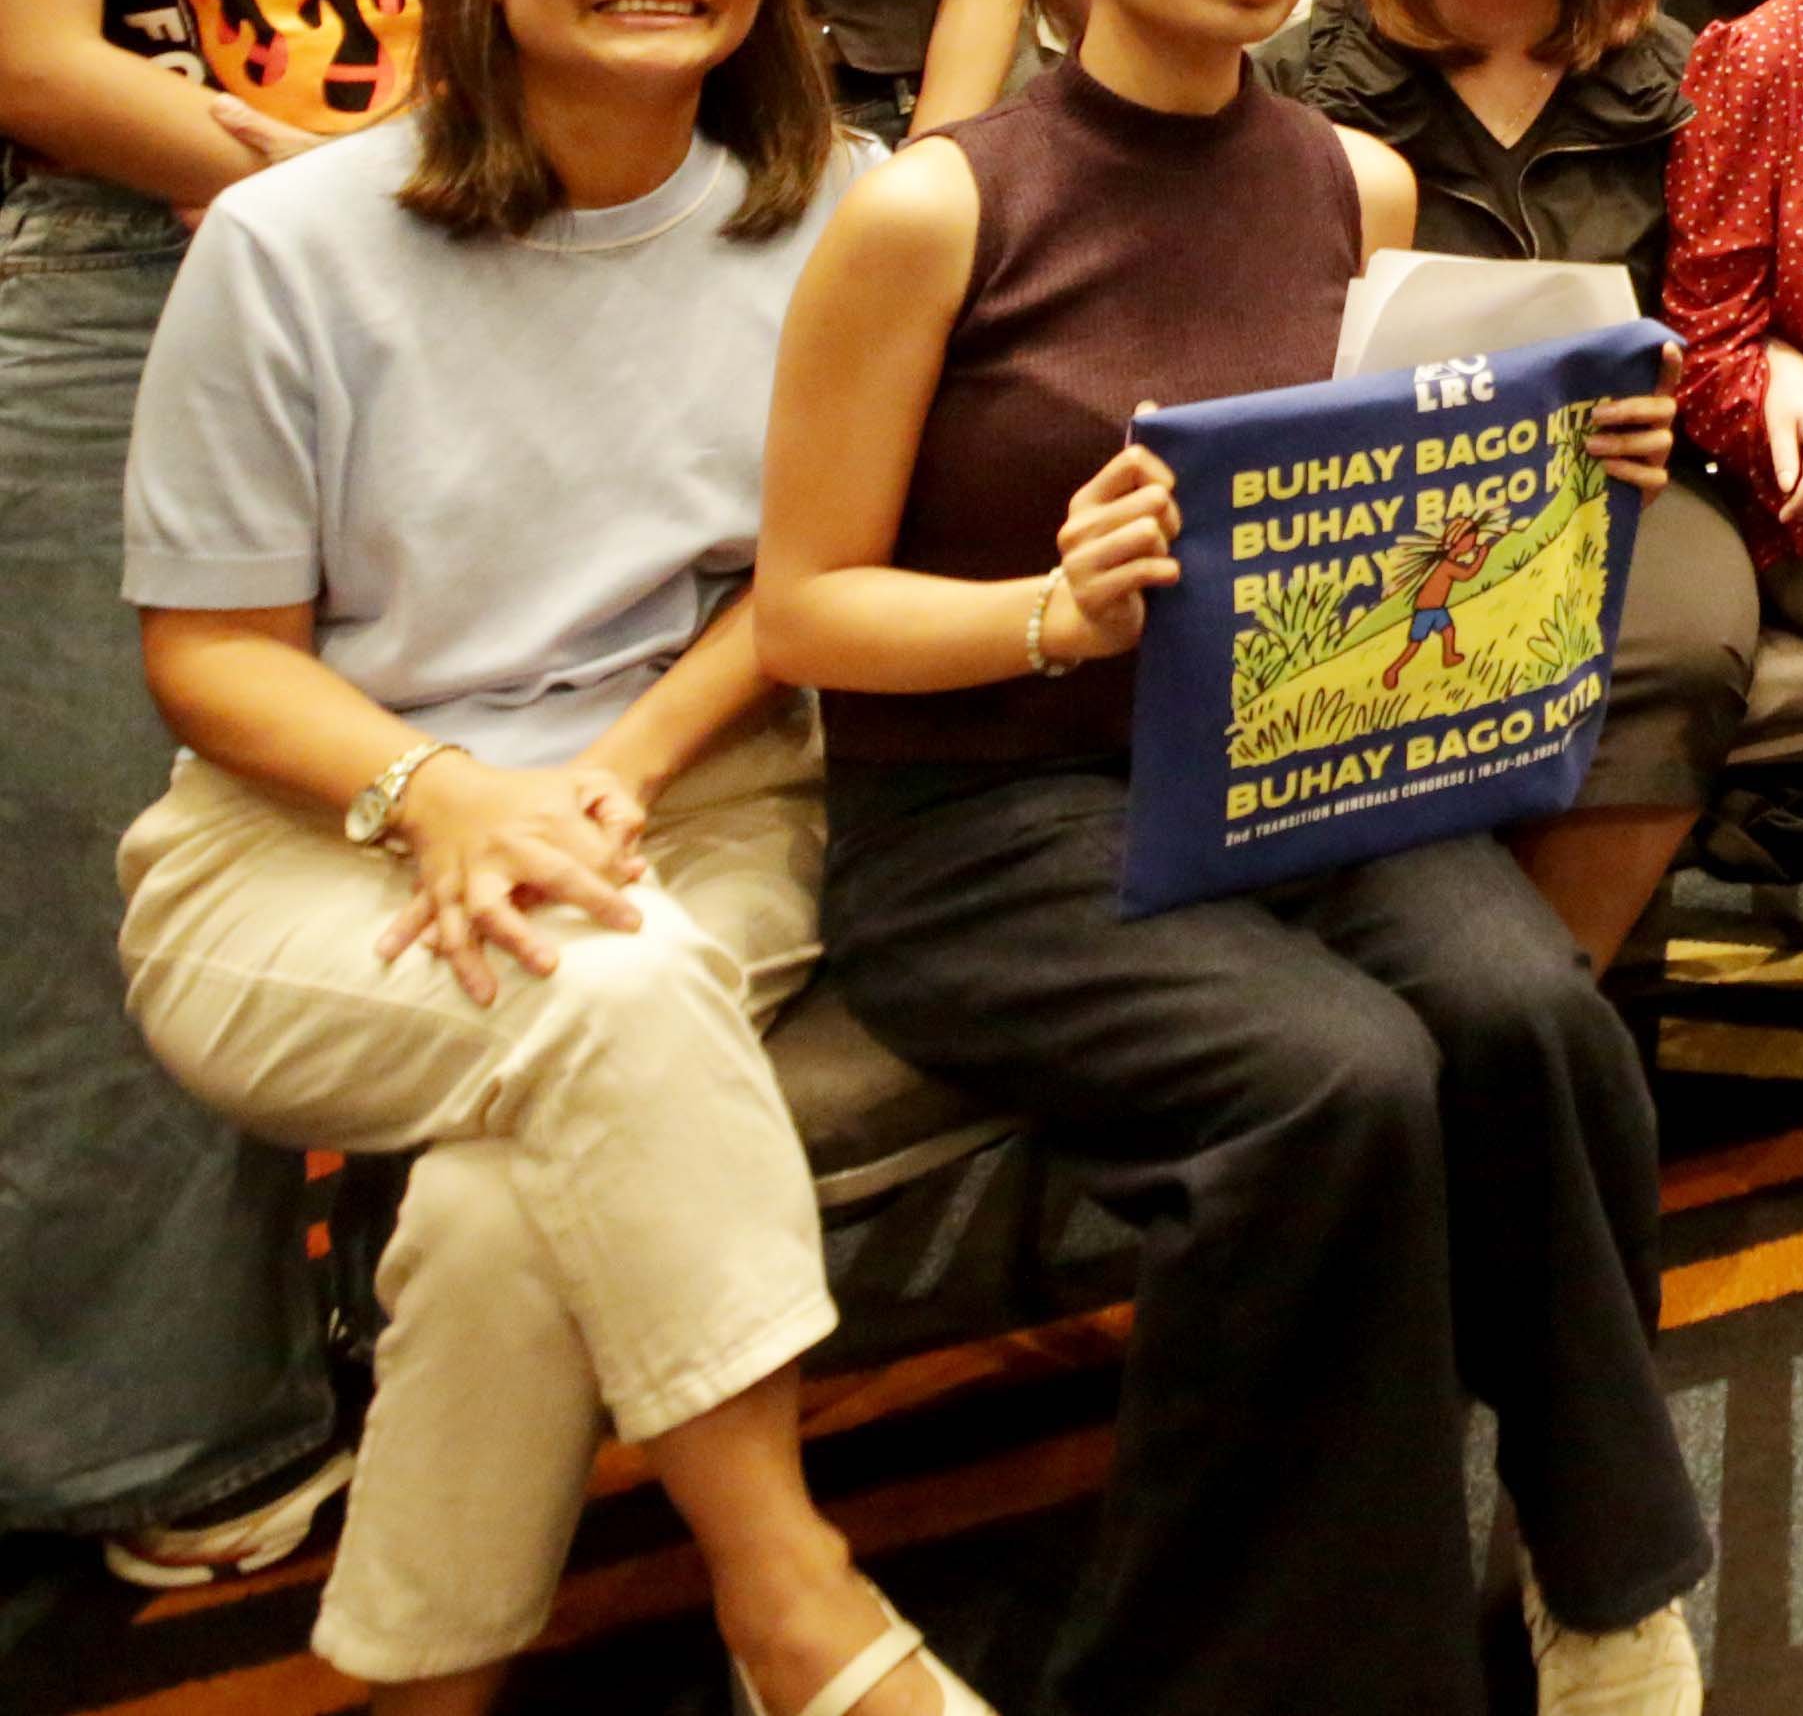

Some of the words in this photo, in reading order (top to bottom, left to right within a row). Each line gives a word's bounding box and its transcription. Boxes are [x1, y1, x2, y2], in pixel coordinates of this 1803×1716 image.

[1416, 370, 1495, 413] LRC
[1231, 445, 1404, 510] BUHAY
[1415, 418, 1539, 476] BAGO
[1231, 496, 1404, 561] BUHAY
[1226, 744, 1395, 821] BUHAY
[1405, 707, 1533, 772] BAGO
[1544, 672, 1602, 733] KITA
[1225, 829, 1251, 848] 2nd
[1255, 803, 1331, 838] TRANSITION
